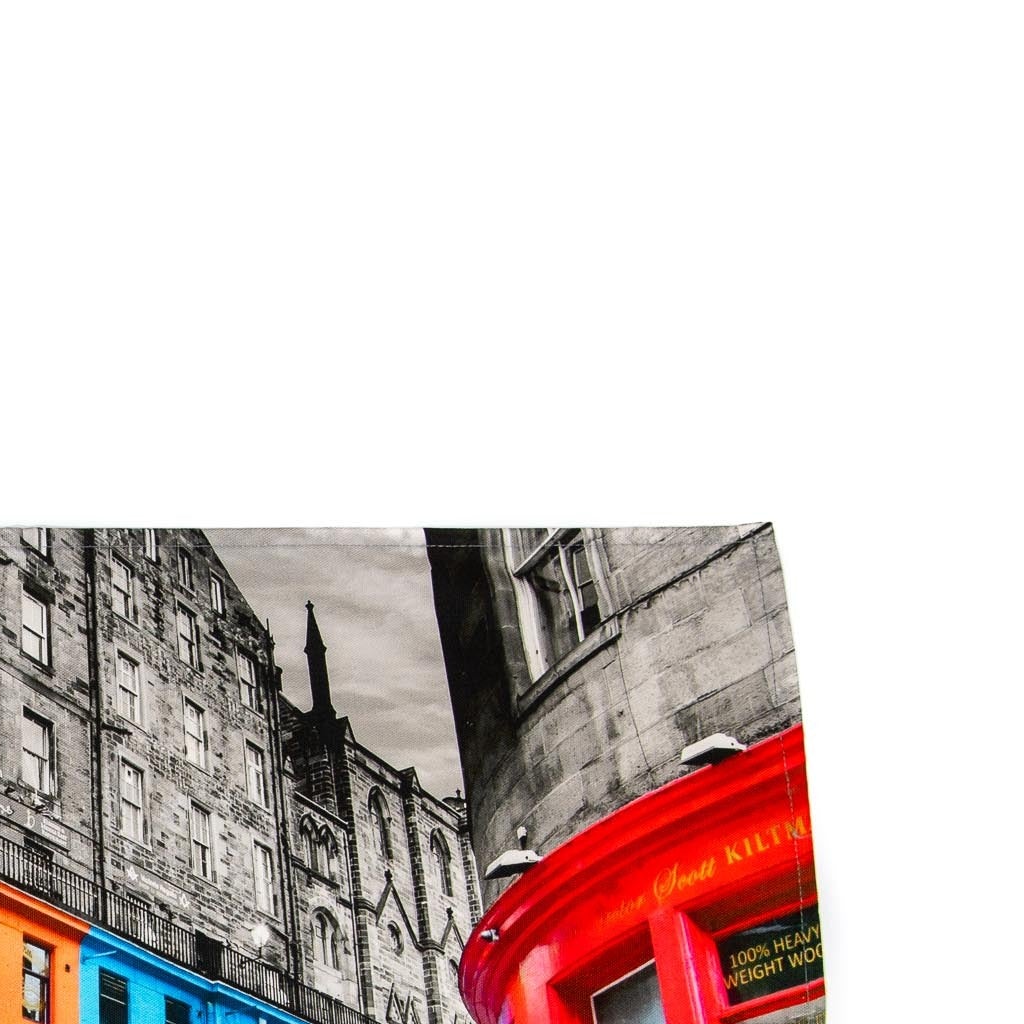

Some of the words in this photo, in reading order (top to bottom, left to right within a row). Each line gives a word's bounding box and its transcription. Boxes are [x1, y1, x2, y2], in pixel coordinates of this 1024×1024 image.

[653, 858, 717, 904] Scott
[729, 944, 771, 969] 100%
[773, 923, 820, 953] HEAVY
[723, 956, 784, 990] WEIGHT
